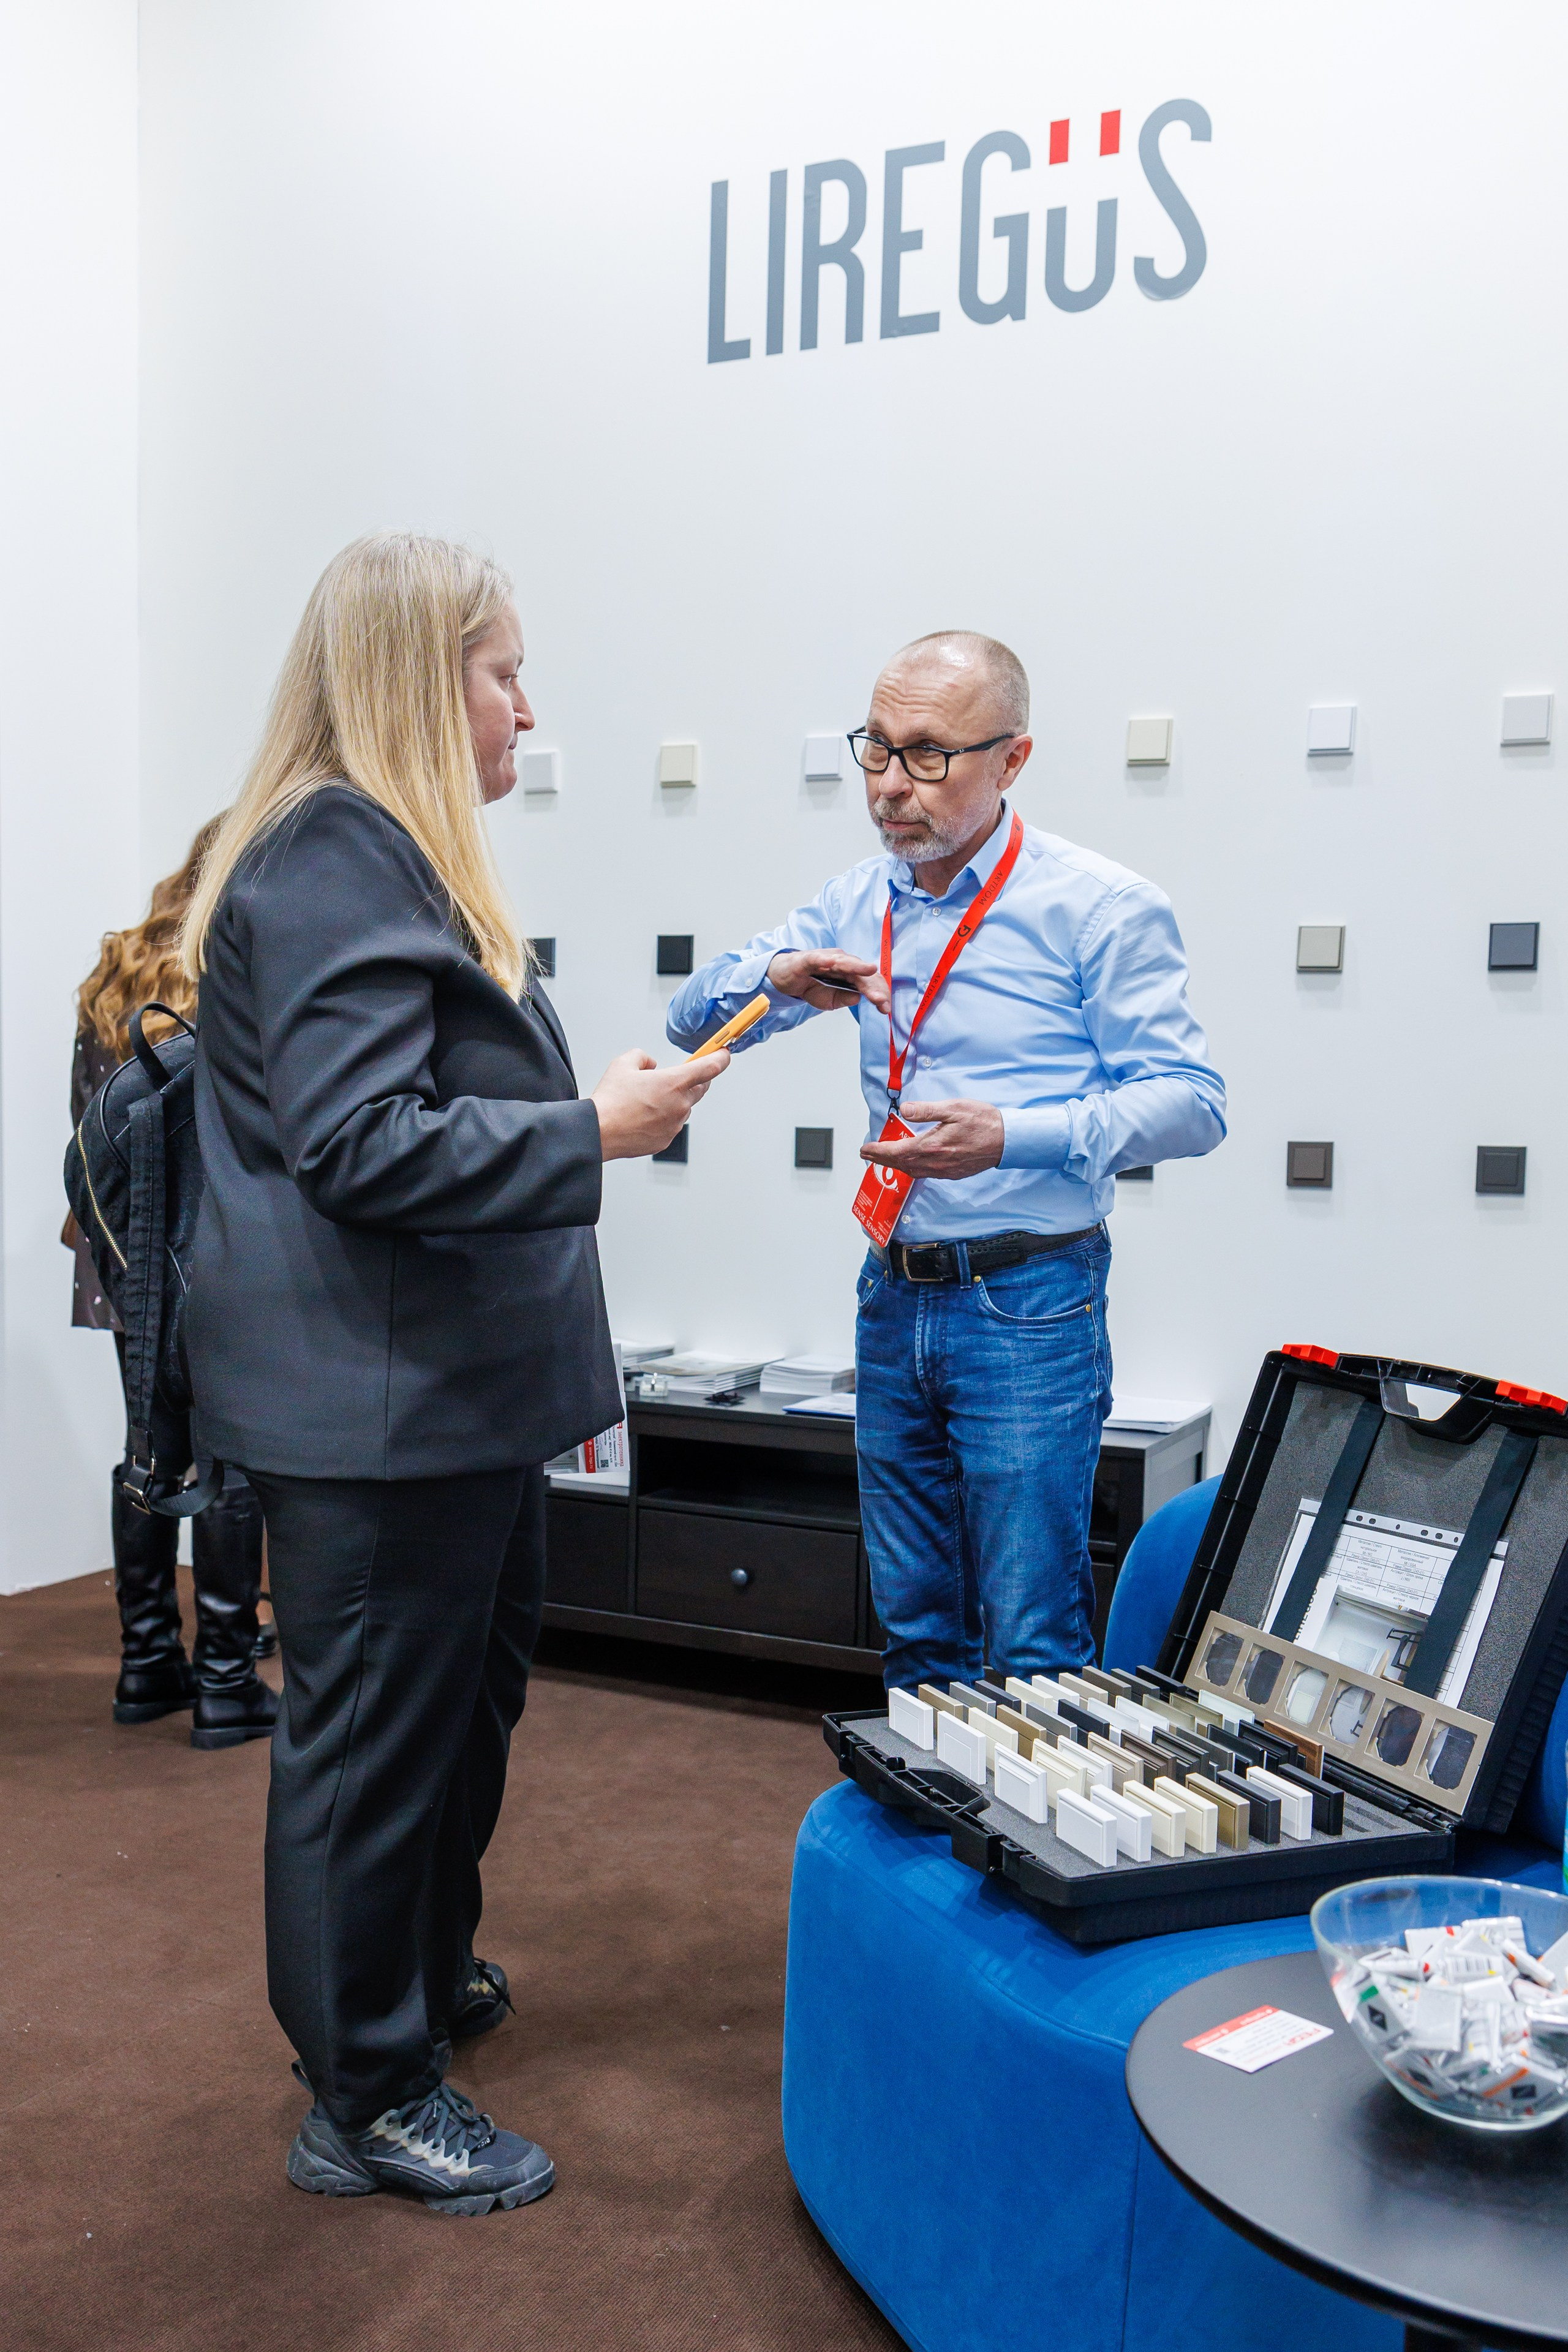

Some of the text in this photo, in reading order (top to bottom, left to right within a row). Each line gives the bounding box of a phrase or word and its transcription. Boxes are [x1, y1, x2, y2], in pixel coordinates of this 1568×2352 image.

[978, 869, 1003, 905] ARTDOM
[919, 971, 941, 1009] ARTDOM
[852, 1204, 867, 1222] SENSE
[865, 1219, 886, 1244] SENSORY
